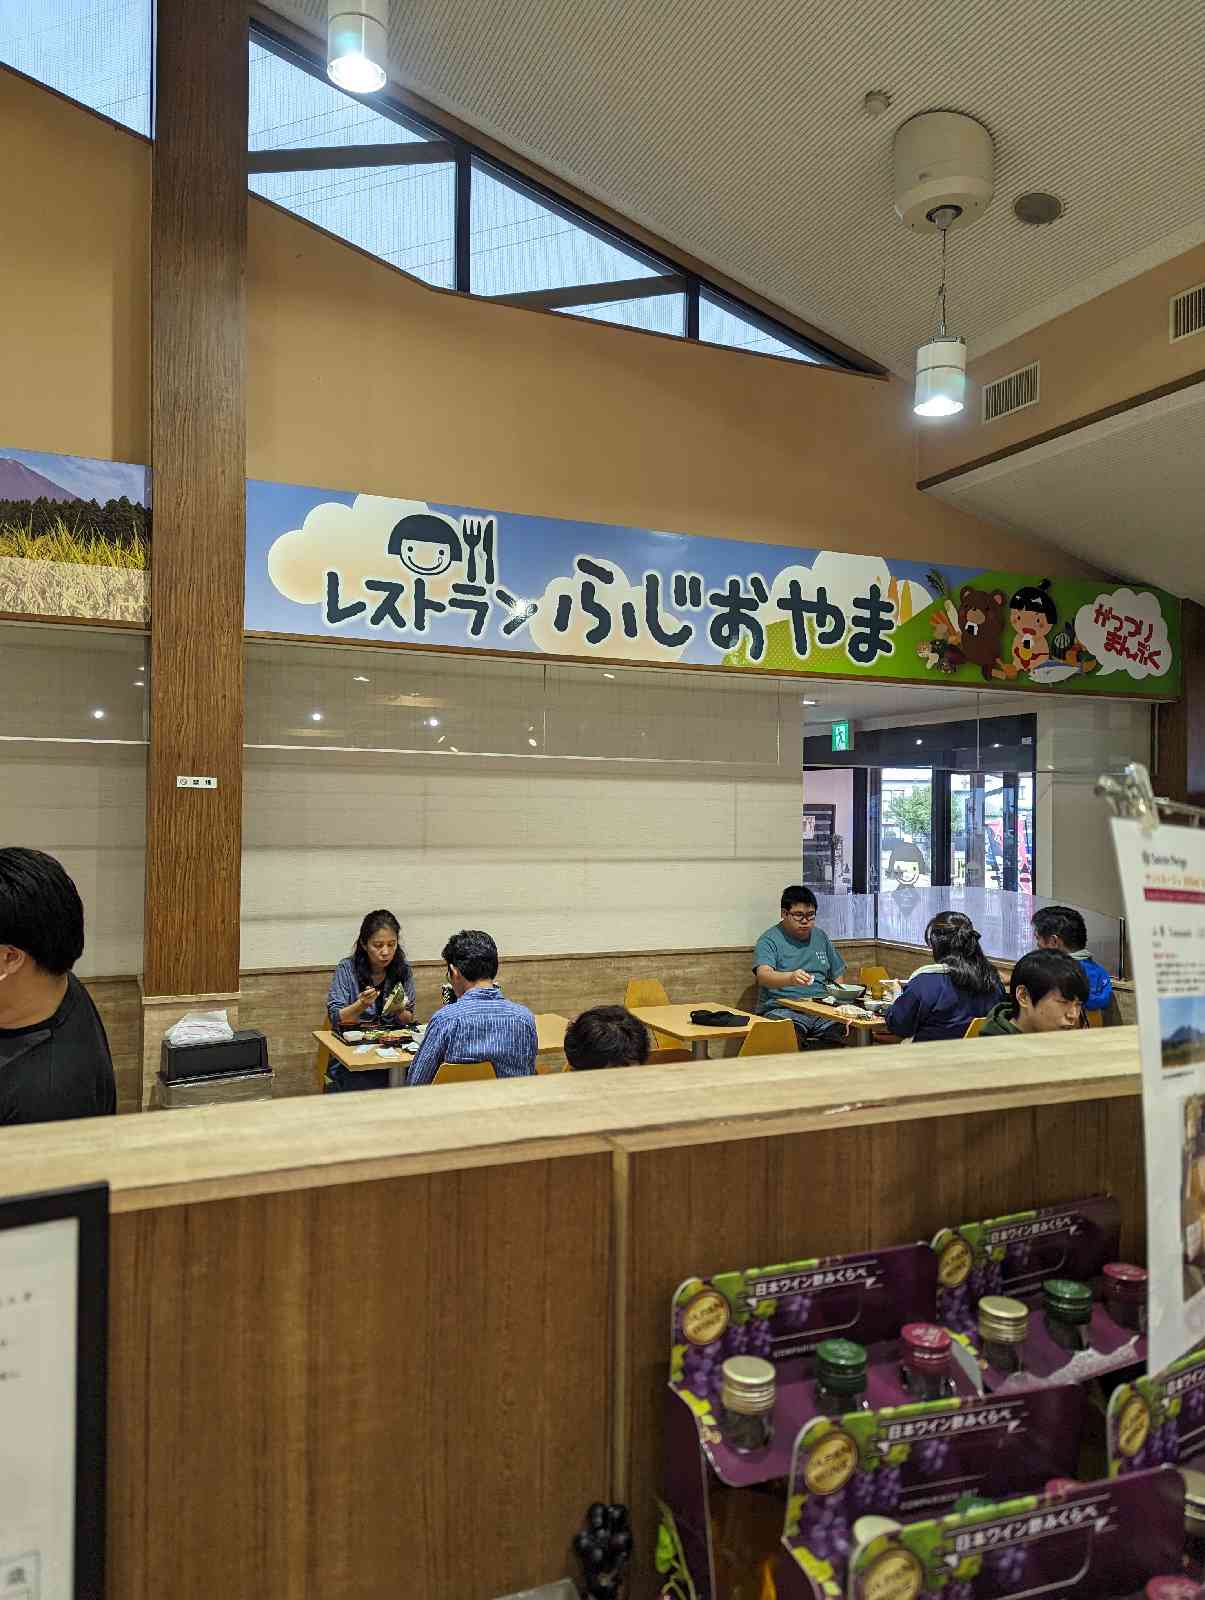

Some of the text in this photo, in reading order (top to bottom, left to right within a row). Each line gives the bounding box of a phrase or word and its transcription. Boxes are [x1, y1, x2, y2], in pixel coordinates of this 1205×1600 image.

[326, 555, 897, 664] レストラン ふじおやま
[1103, 630, 1162, 670] まんぷく
